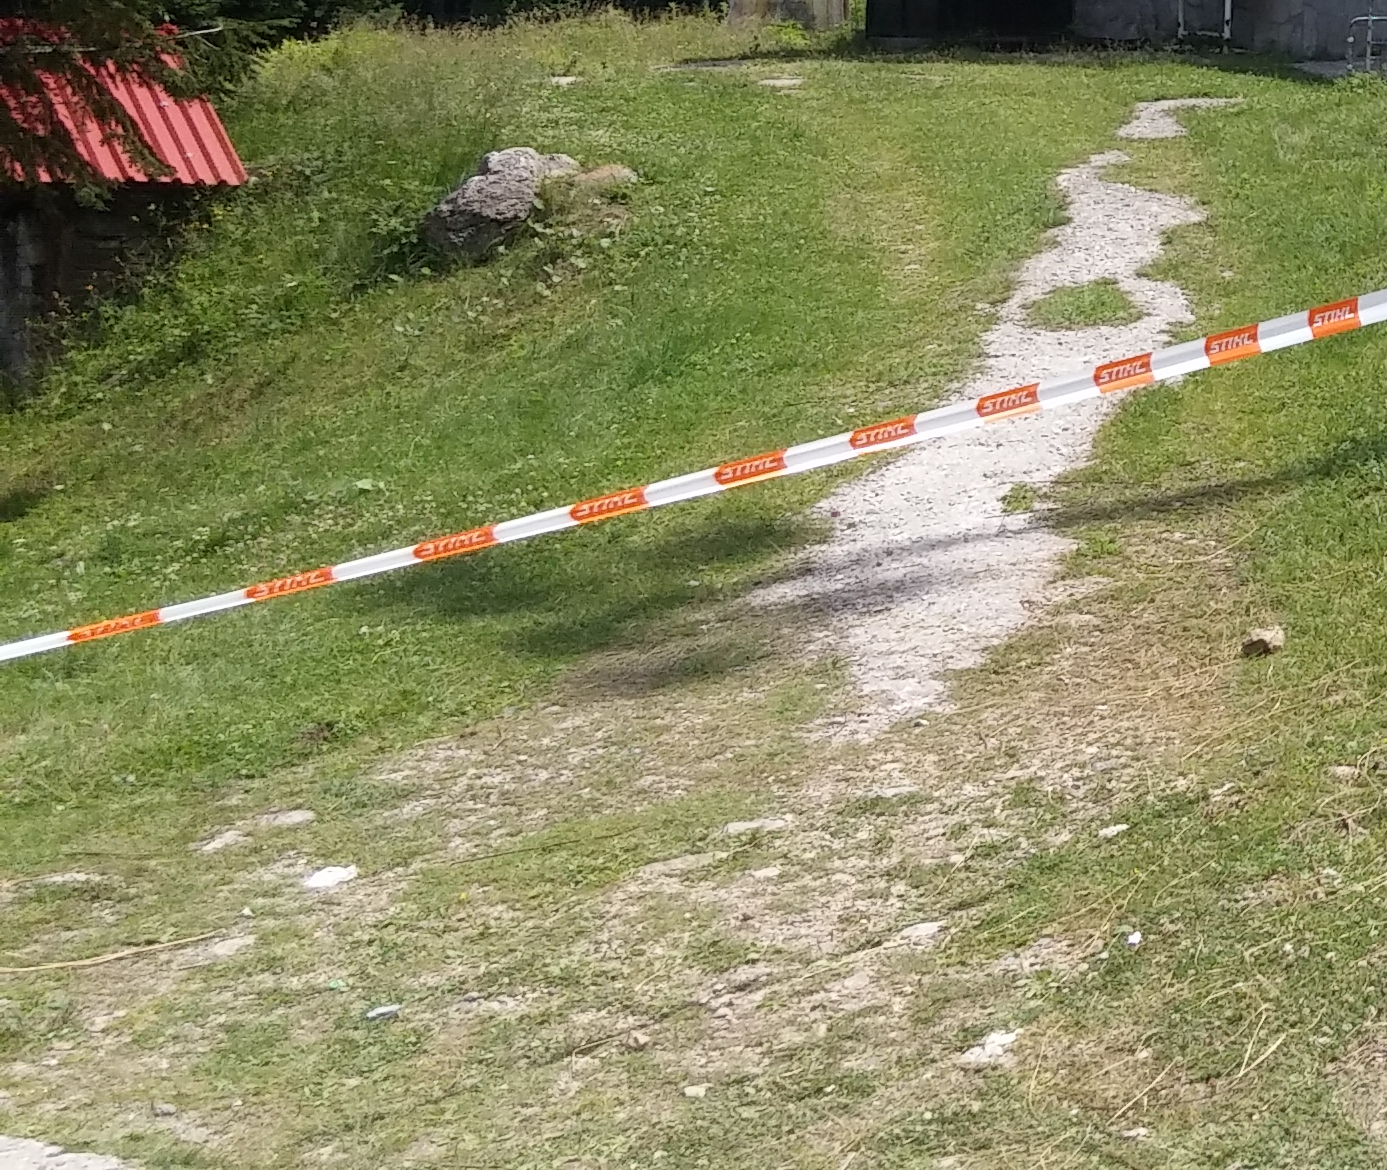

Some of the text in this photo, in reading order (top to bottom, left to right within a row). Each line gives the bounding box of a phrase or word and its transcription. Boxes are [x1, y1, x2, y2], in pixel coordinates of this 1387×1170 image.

[1098, 361, 1147, 382] STIHL
[1209, 332, 1253, 352] STIHL
[1312, 306, 1355, 327] STIHL
